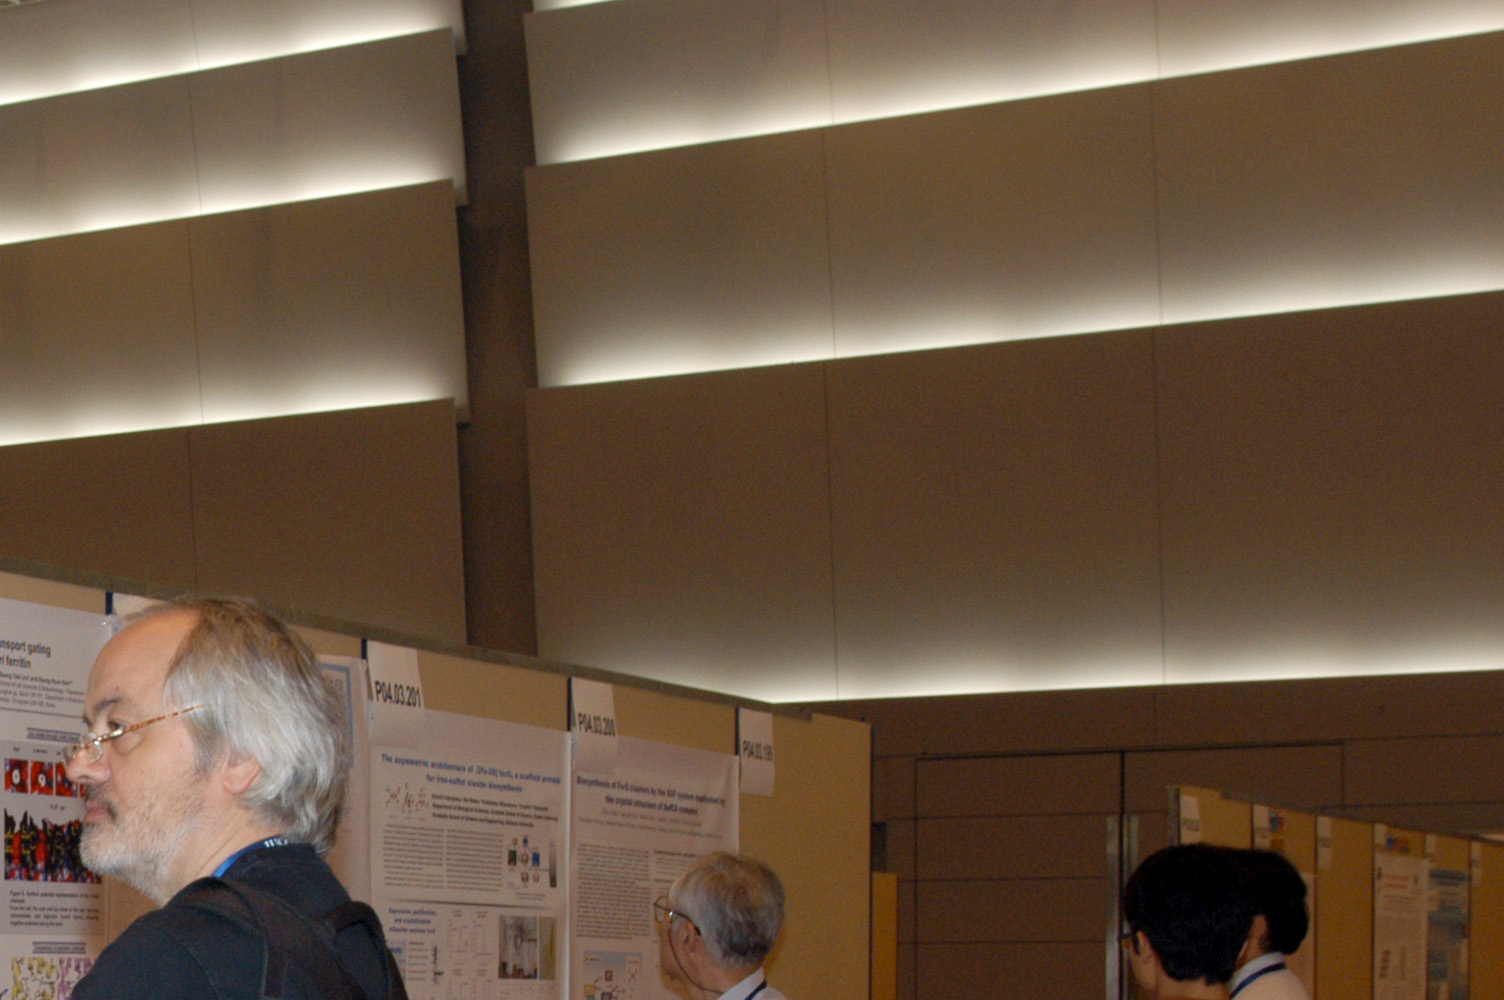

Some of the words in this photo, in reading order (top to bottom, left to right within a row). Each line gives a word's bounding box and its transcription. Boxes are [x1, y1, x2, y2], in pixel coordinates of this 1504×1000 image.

[27, 641, 50, 656] gating
[5, 654, 31, 669] ferritin
[375, 680, 422, 708] P04.03.201
